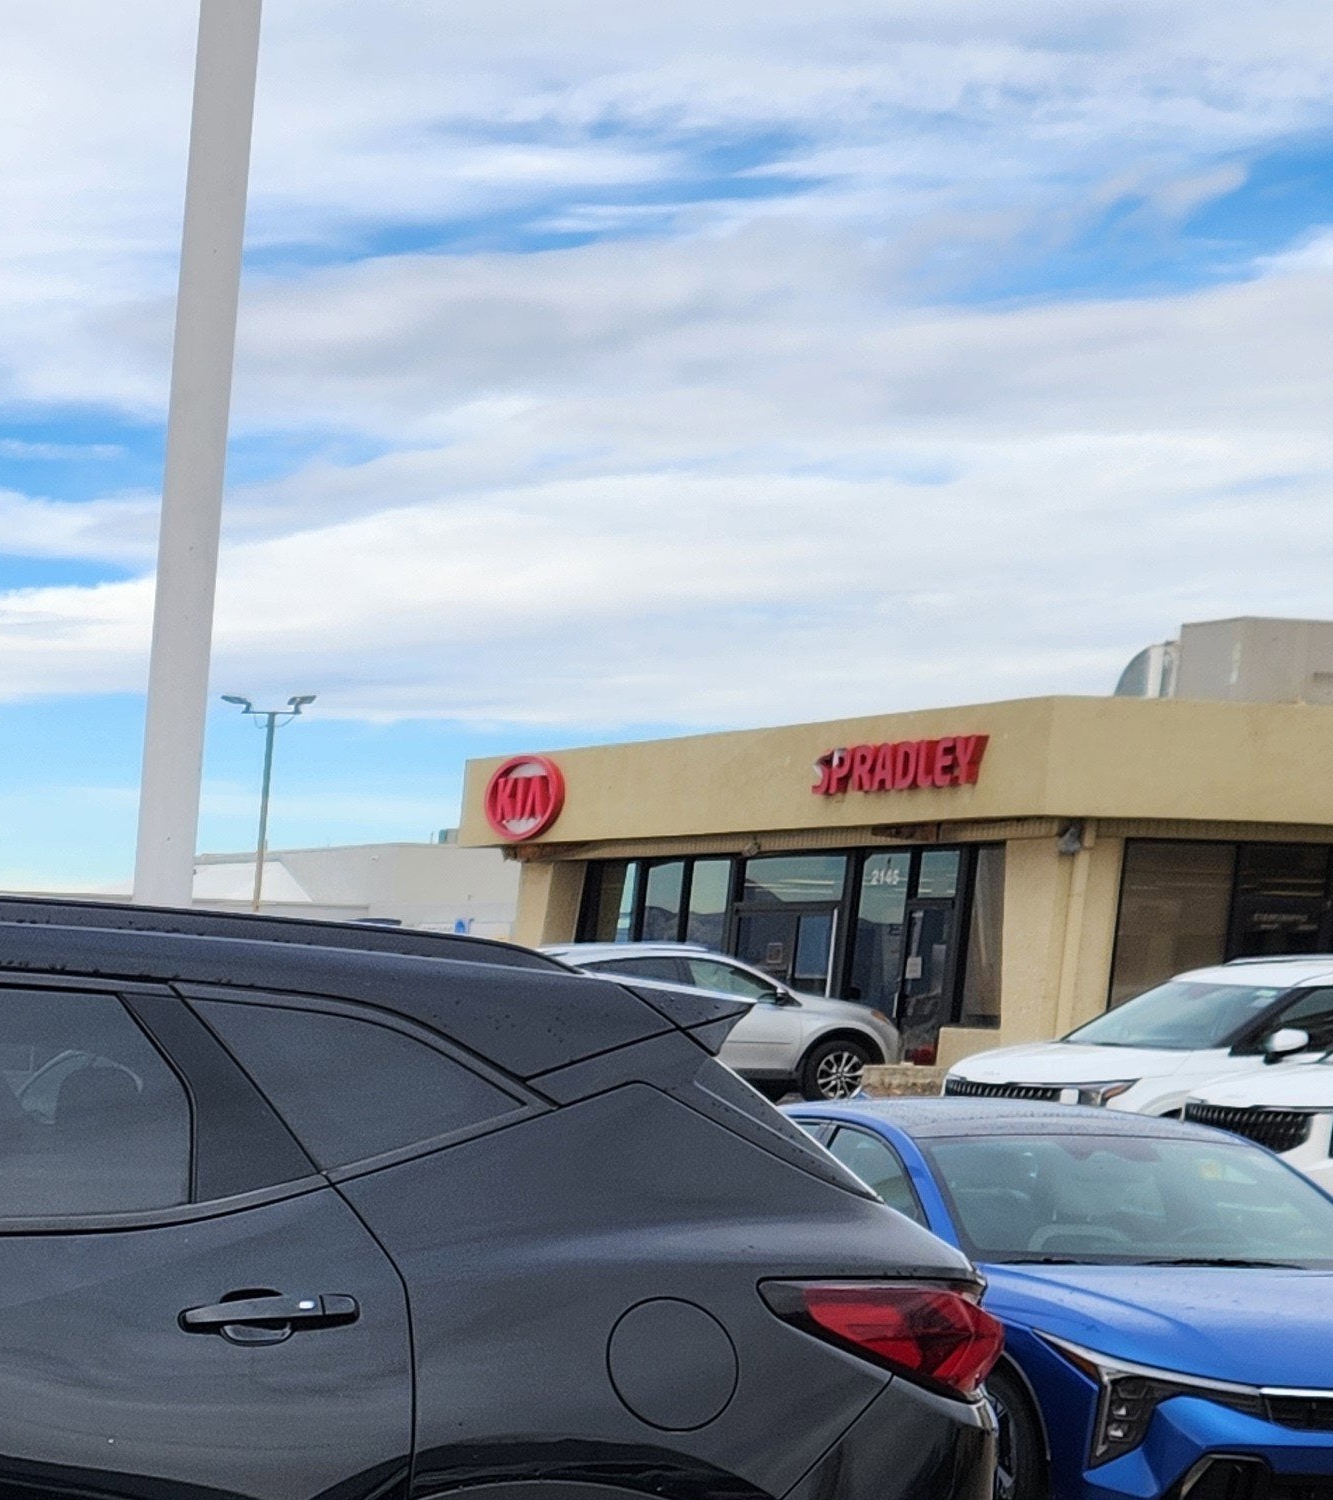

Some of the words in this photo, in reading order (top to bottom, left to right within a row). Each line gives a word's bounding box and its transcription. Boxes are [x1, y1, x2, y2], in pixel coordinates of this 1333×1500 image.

[811, 735, 989, 796] SPRADLEY
[494, 774, 547, 822] KIA
[871, 869, 901, 885] 2145
